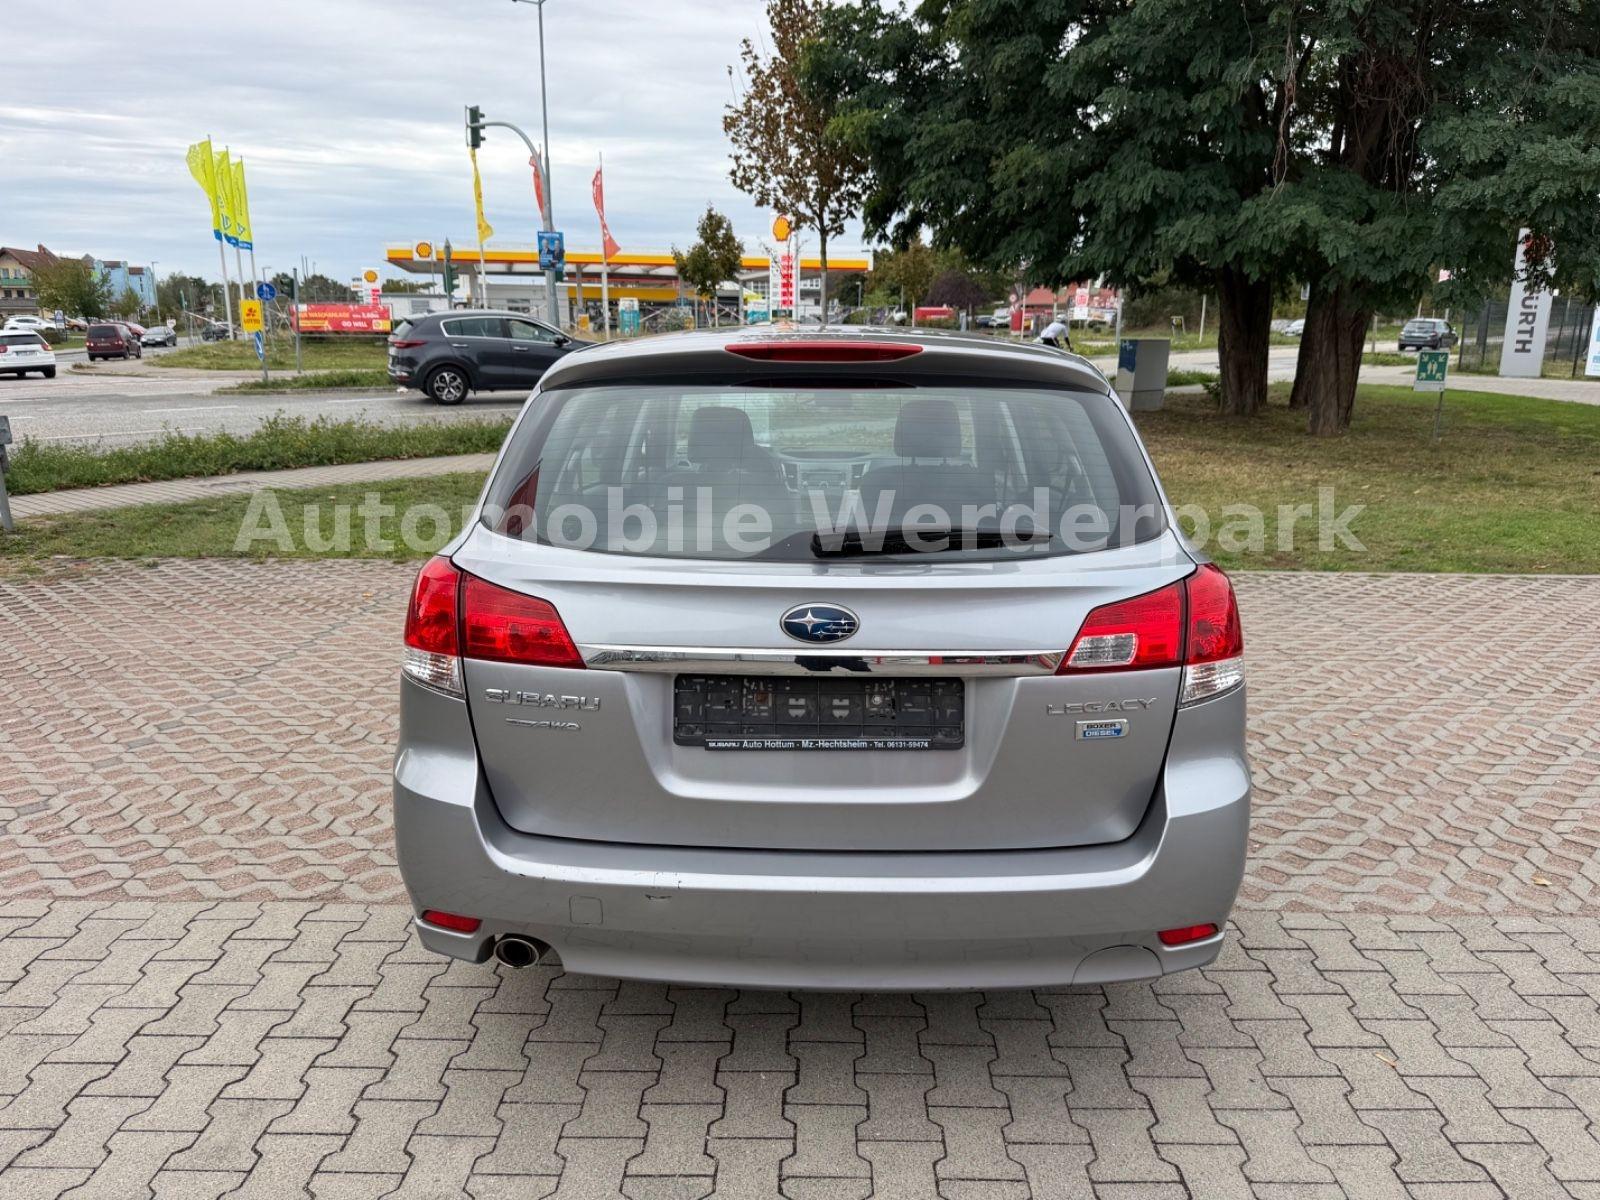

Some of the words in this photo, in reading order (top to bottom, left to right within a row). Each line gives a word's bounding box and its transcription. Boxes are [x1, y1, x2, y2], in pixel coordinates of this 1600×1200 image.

[1514, 286, 1540, 354] ÜRTH
[485, 688, 601, 711] SUBARU
[1047, 697, 1157, 715] LEGACY
[1085, 729, 1118, 737] DIESEL
[742, 740, 763, 749] Auto
[765, 740, 795, 749] Hottum
[802, 740, 868, 749] Mz.-Hechtsheim
